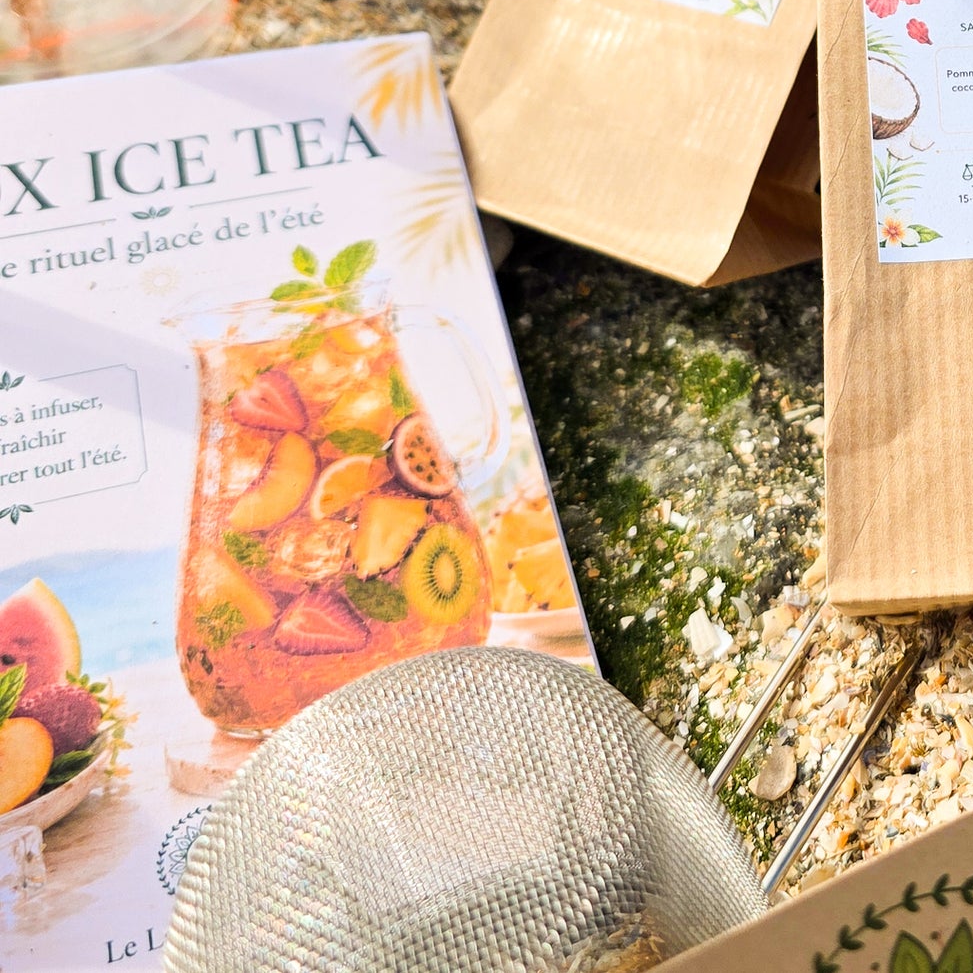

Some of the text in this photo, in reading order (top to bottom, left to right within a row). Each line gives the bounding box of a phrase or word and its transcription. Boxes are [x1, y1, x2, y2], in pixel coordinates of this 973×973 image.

[82, 134, 217, 203] ICE
[233, 112, 387, 177] TEA
[29, 236, 118, 274] rituel
[127, 222, 203, 264] glacé
[214, 216, 251, 242] de
[259, 202, 325, 234] l'été
[14, 407, 25, 423] à
[31, 396, 103, 421] infuser,
[0, 428, 67, 455] raîchir
[34, 458, 75, 478] tout
[81, 443, 127, 469] l'été.
[106, 927, 168, 964] Le L
